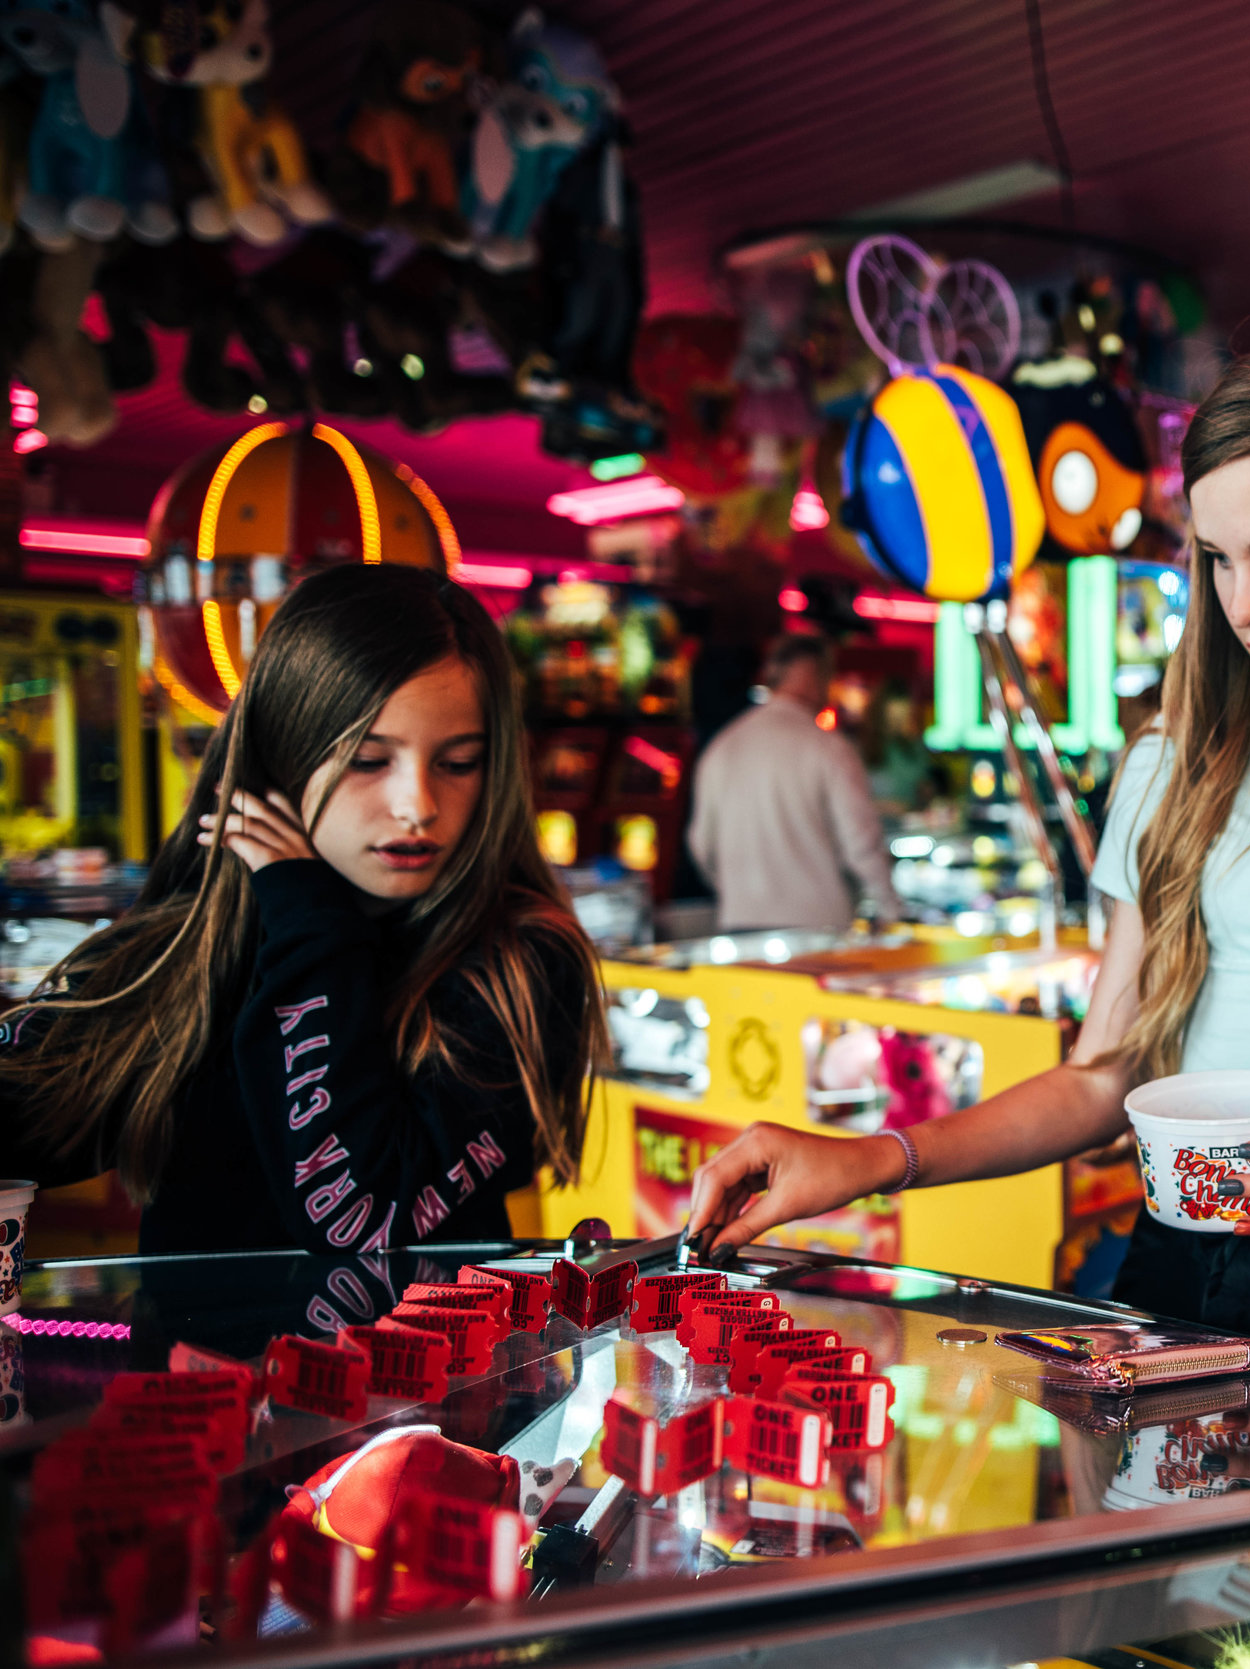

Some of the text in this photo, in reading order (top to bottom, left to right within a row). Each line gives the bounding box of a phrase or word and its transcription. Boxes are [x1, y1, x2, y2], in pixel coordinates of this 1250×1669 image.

[274, 994, 506, 1253] NEW YORK CITY
[1211, 1147, 1239, 1158] BAR
[530, 1276, 544, 1286] AND
[645, 1278, 673, 1288] PRIZES
[692, 1292, 722, 1301] PRIZES
[704, 1306, 734, 1317] PRIZES
[810, 1385, 858, 1402] ONE
[753, 1403, 795, 1428] ONE
[831, 1432, 862, 1448] KET
[747, 1452, 797, 1478] TICKET
